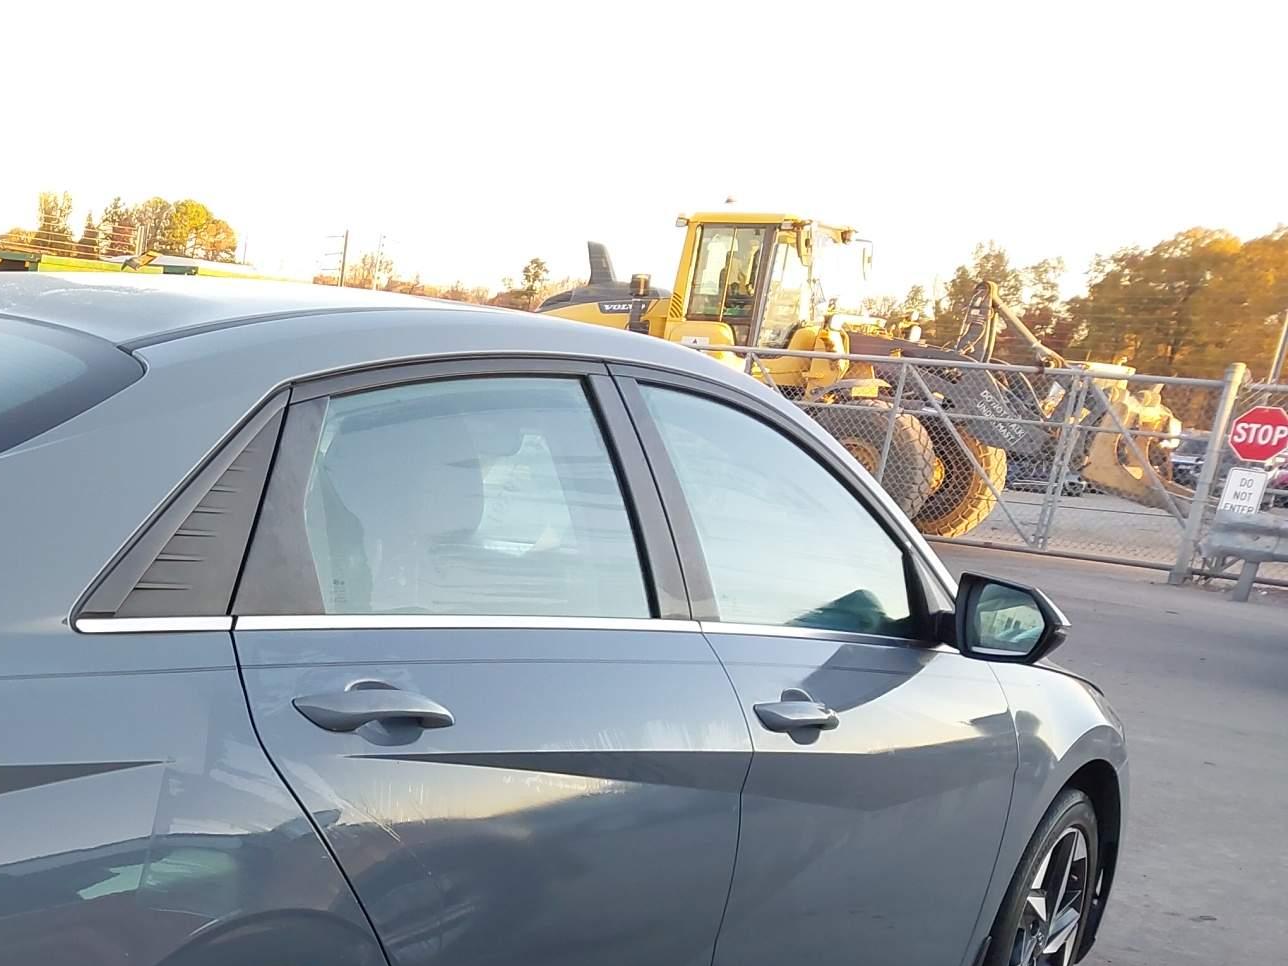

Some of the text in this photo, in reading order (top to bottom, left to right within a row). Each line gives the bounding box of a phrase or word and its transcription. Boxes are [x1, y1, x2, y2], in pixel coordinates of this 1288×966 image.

[1233, 422, 1288, 446] STOP
[1239, 478, 1254, 488] DO
[1232, 491, 1253, 501] NOT
